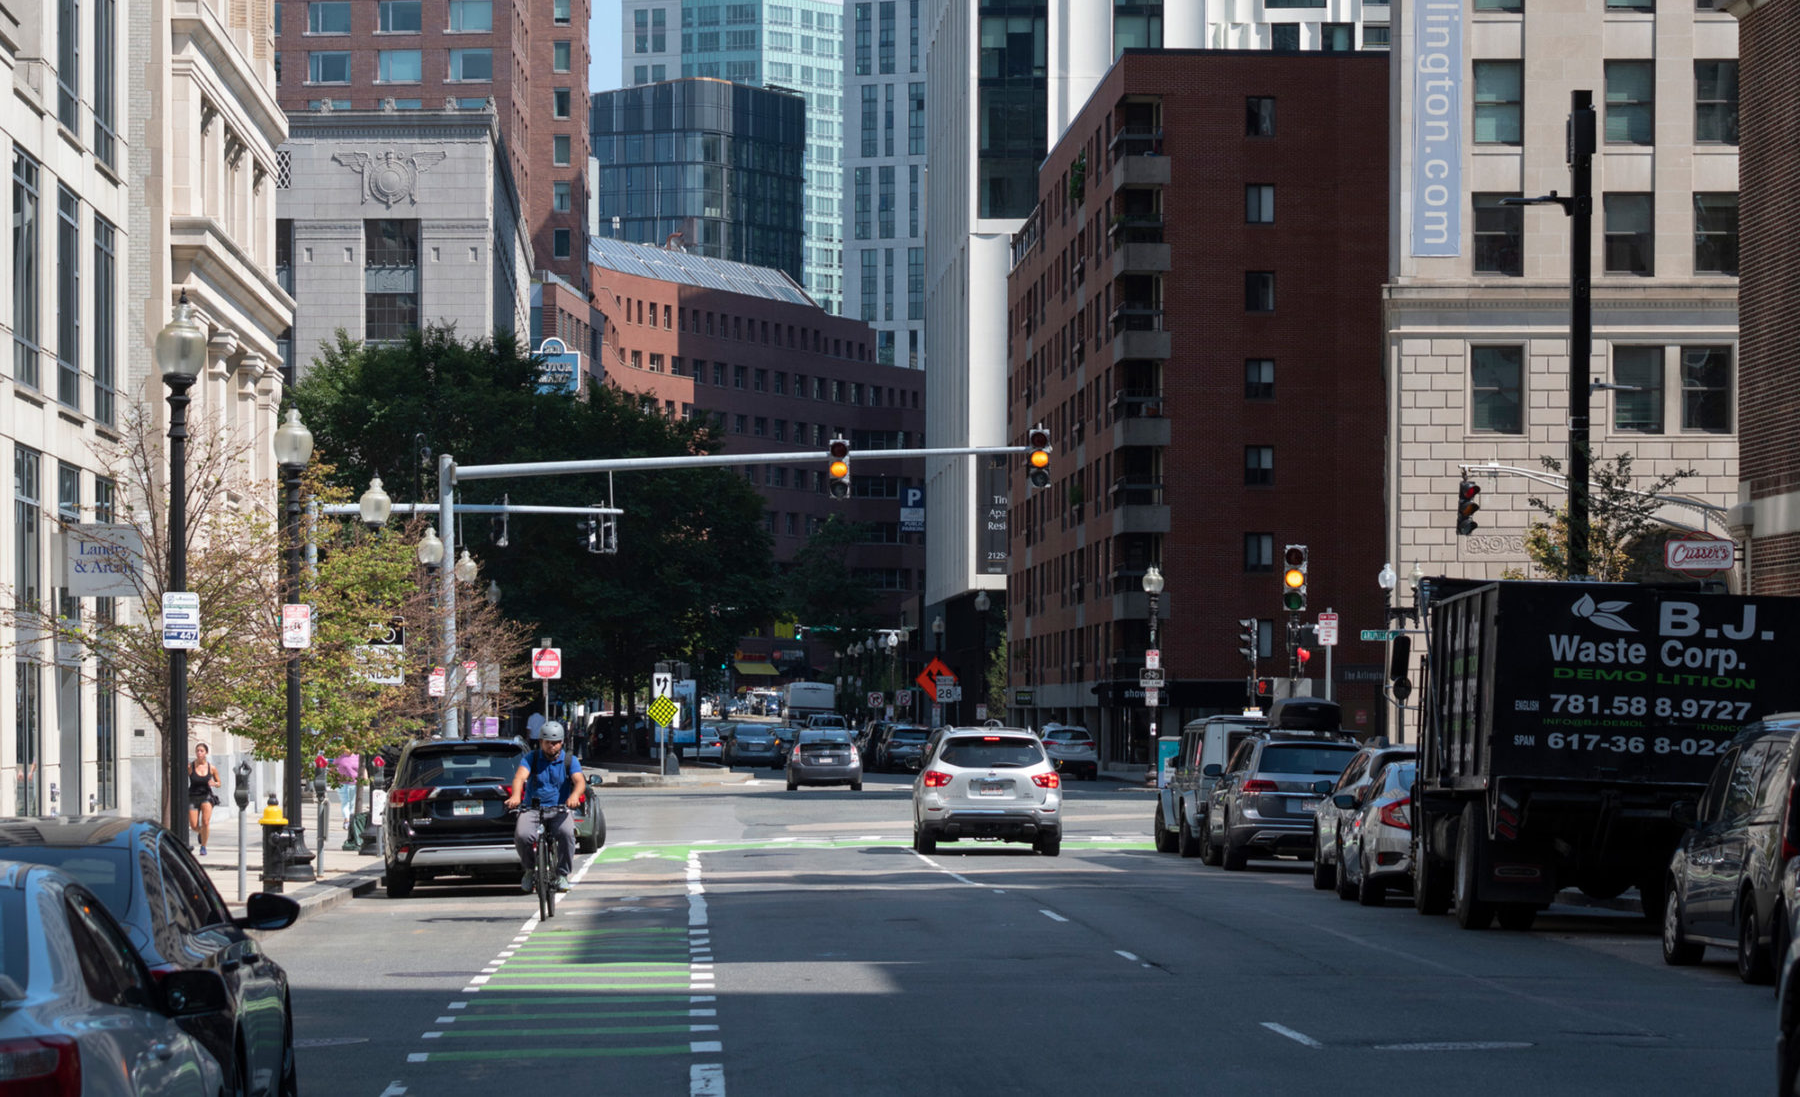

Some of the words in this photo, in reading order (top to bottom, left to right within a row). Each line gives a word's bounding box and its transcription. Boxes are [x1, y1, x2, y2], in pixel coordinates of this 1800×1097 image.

[907, 488, 922, 507] P
[80, 541, 127, 557] Landry
[1672, 543, 1730, 566] Cusser's
[74, 558, 88, 574] &
[1658, 601, 1775, 640] B.J.
[179, 631, 198, 641] 447
[1548, 633, 1647, 664] Waste
[1660, 639, 1746, 676] Corp.
[938, 688, 953, 699] 28
[1514, 700, 1540, 711] ENGLISH
[1514, 734, 1535, 746] SPAN
